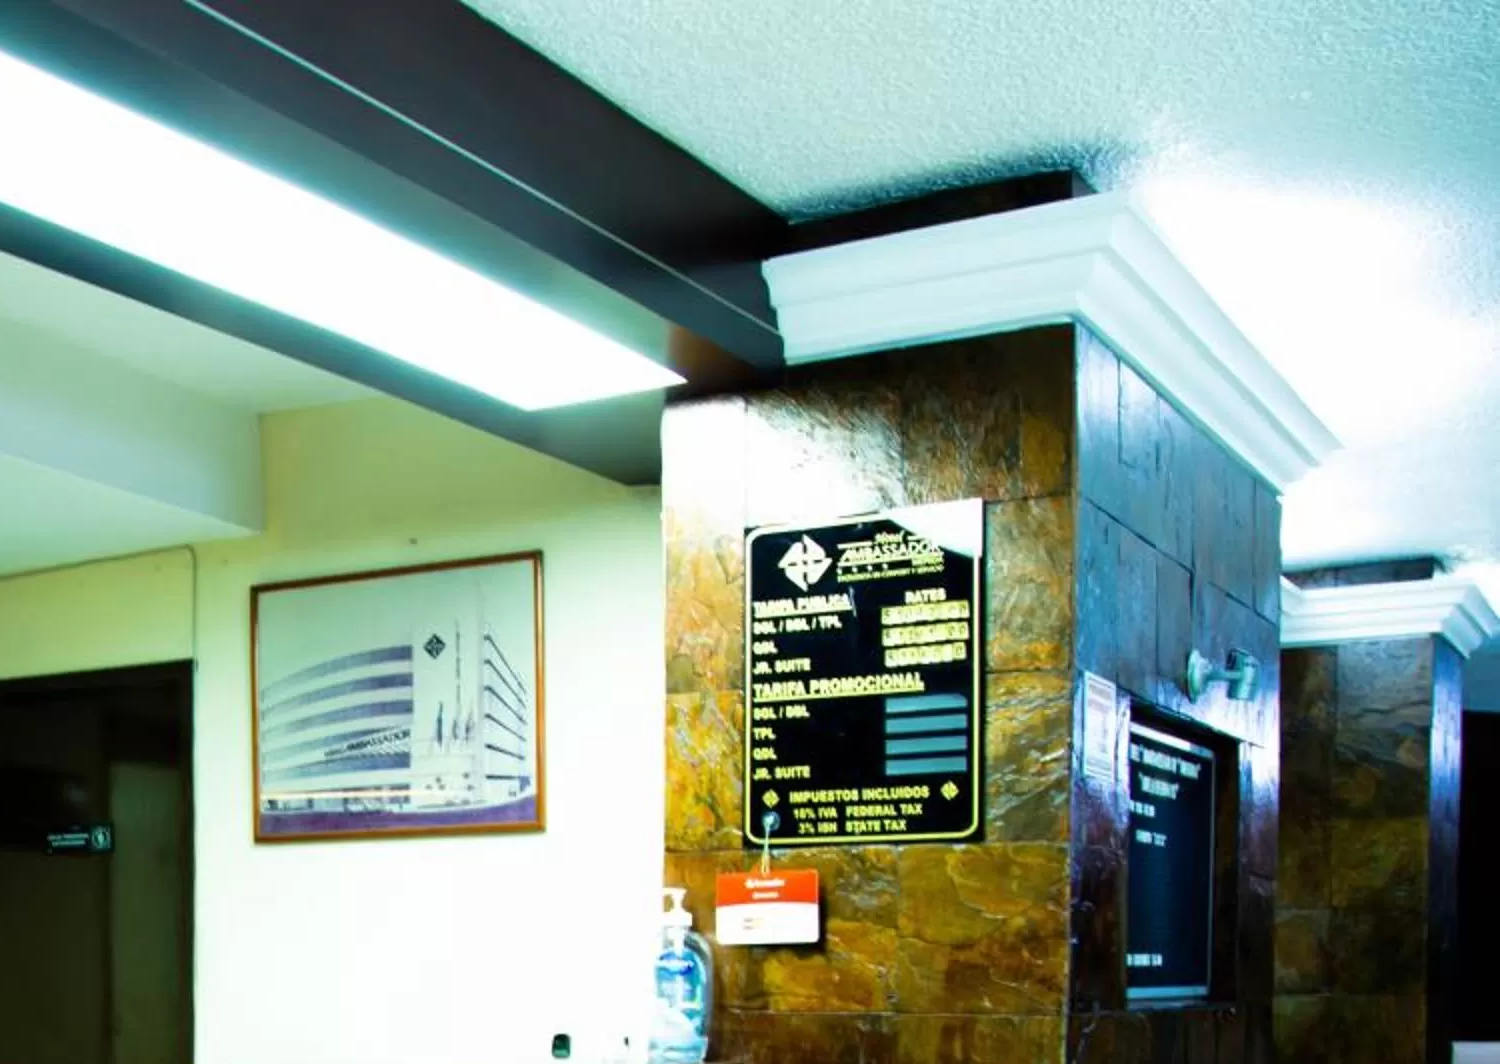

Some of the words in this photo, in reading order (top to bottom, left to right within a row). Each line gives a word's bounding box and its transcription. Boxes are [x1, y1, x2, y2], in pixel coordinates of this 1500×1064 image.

[774, 657, 811, 673] SUITE
[752, 680, 806, 701] TARIFA
[808, 671, 925, 694] PROMOCIONAL
[775, 765, 811, 779] SUITE
[789, 788, 859, 804] IMPUESTOS
[845, 804, 897, 818] FEDERAL
[899, 803, 923, 815] TAX
[883, 819, 907, 832] TAX
